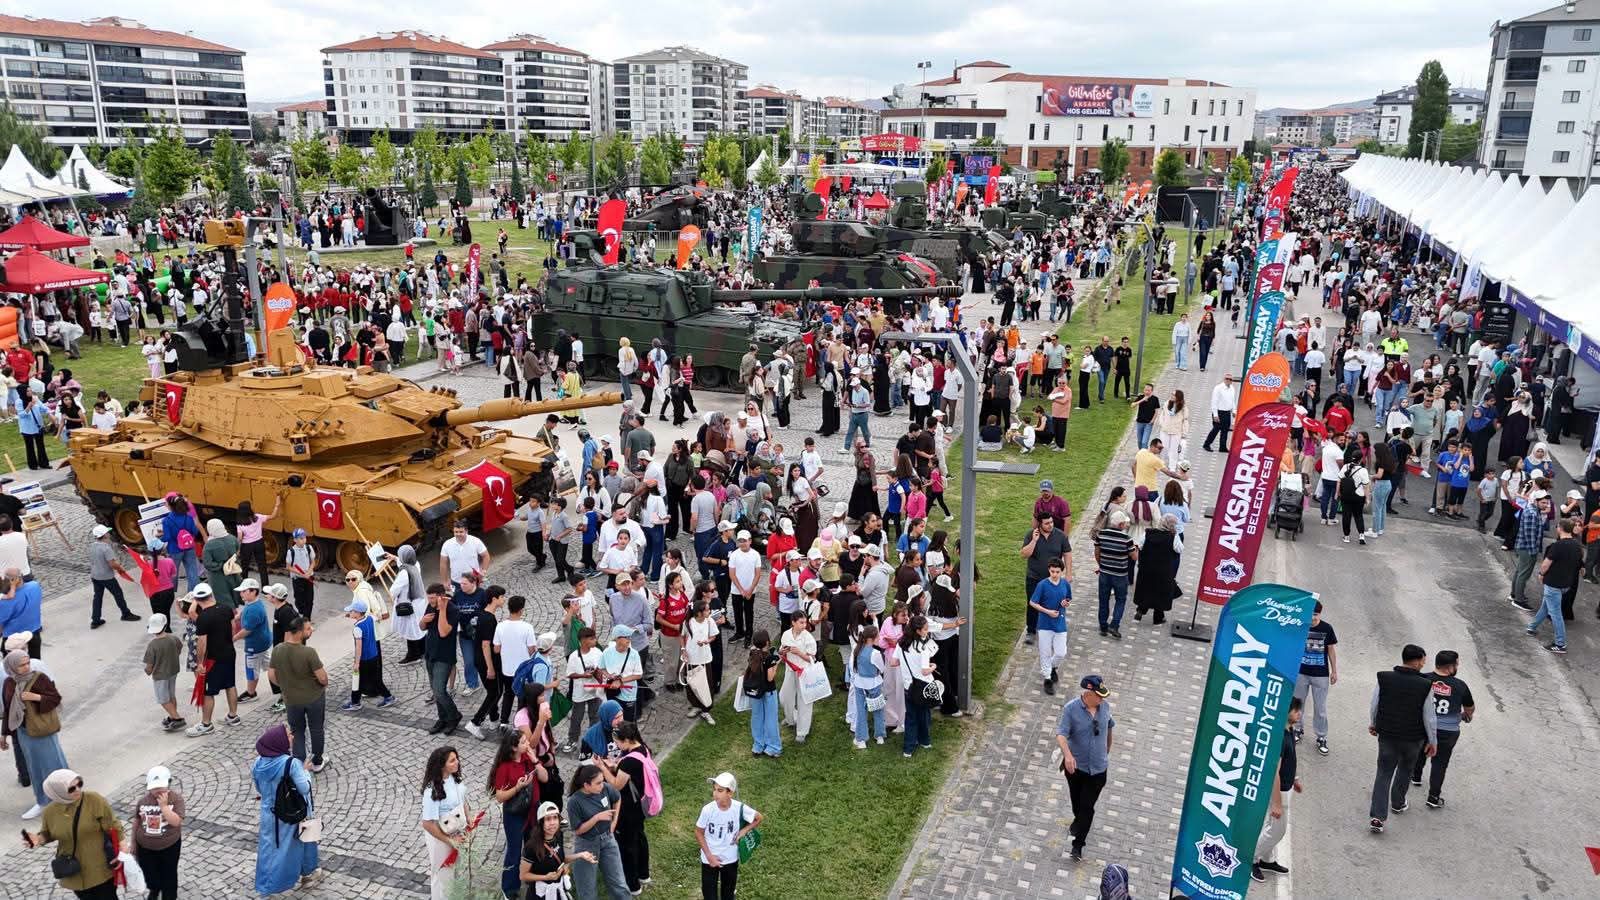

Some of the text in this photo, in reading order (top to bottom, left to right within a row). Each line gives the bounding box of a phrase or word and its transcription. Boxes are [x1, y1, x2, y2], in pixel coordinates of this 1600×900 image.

[1248, 305, 1271, 367] SARAY
[1218, 428, 1267, 553] AKSARAY
[1262, 607, 1303, 626] Değer
[1201, 623, 1270, 827] AKSARAY
[1243, 673, 1283, 801] BELEDİYESİ
[1433, 698, 1450, 715] 8
